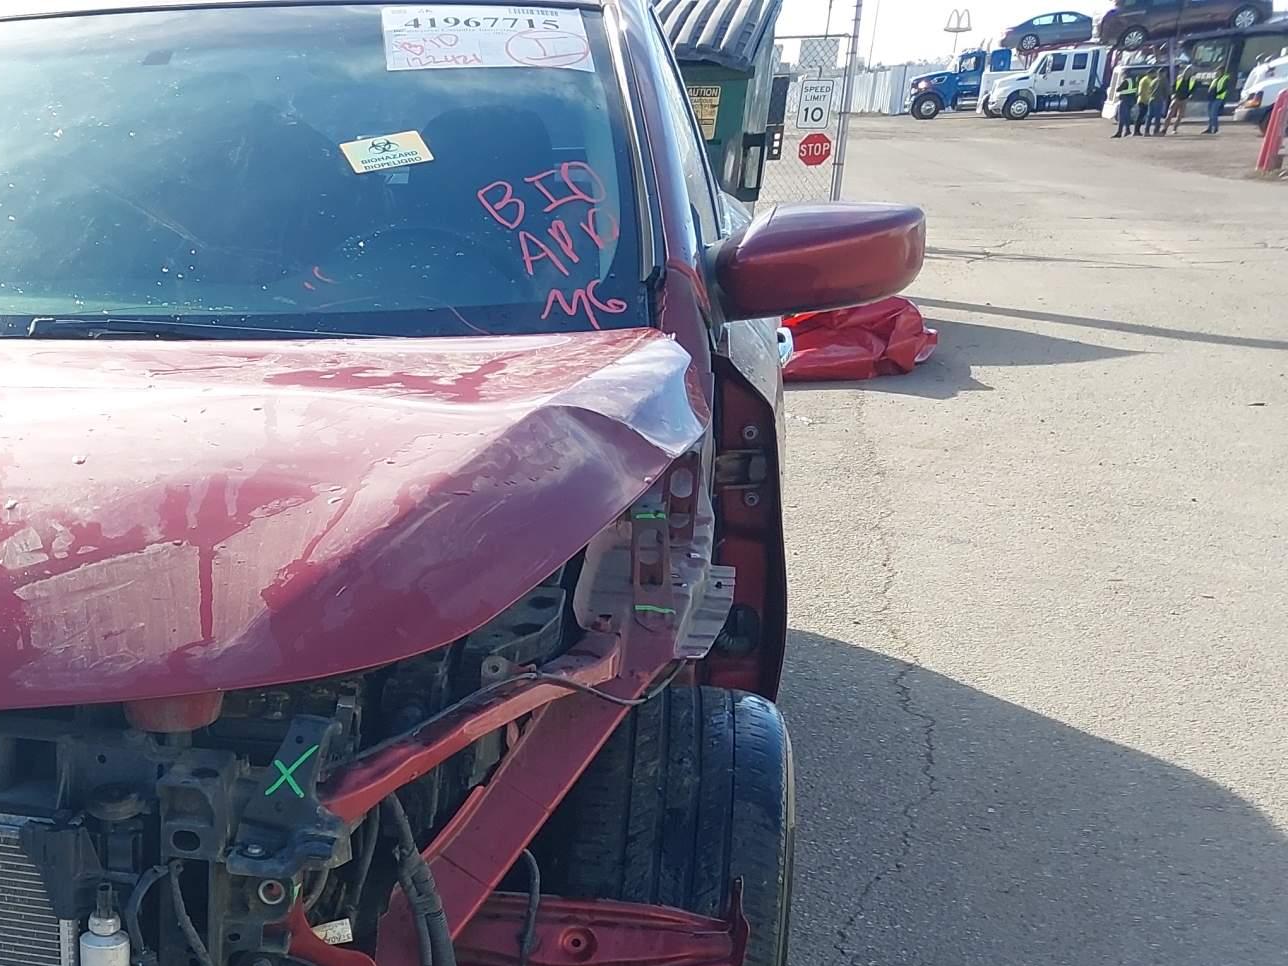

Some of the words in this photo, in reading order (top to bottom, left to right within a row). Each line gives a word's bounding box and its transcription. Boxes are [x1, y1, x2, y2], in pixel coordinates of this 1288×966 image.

[405, 16, 560, 30] 41967715
[687, 88, 719, 97] AUTION
[804, 107, 824, 122] 10
[799, 142, 830, 157] STOP
[361, 150, 419, 165] BIOHAZARD
